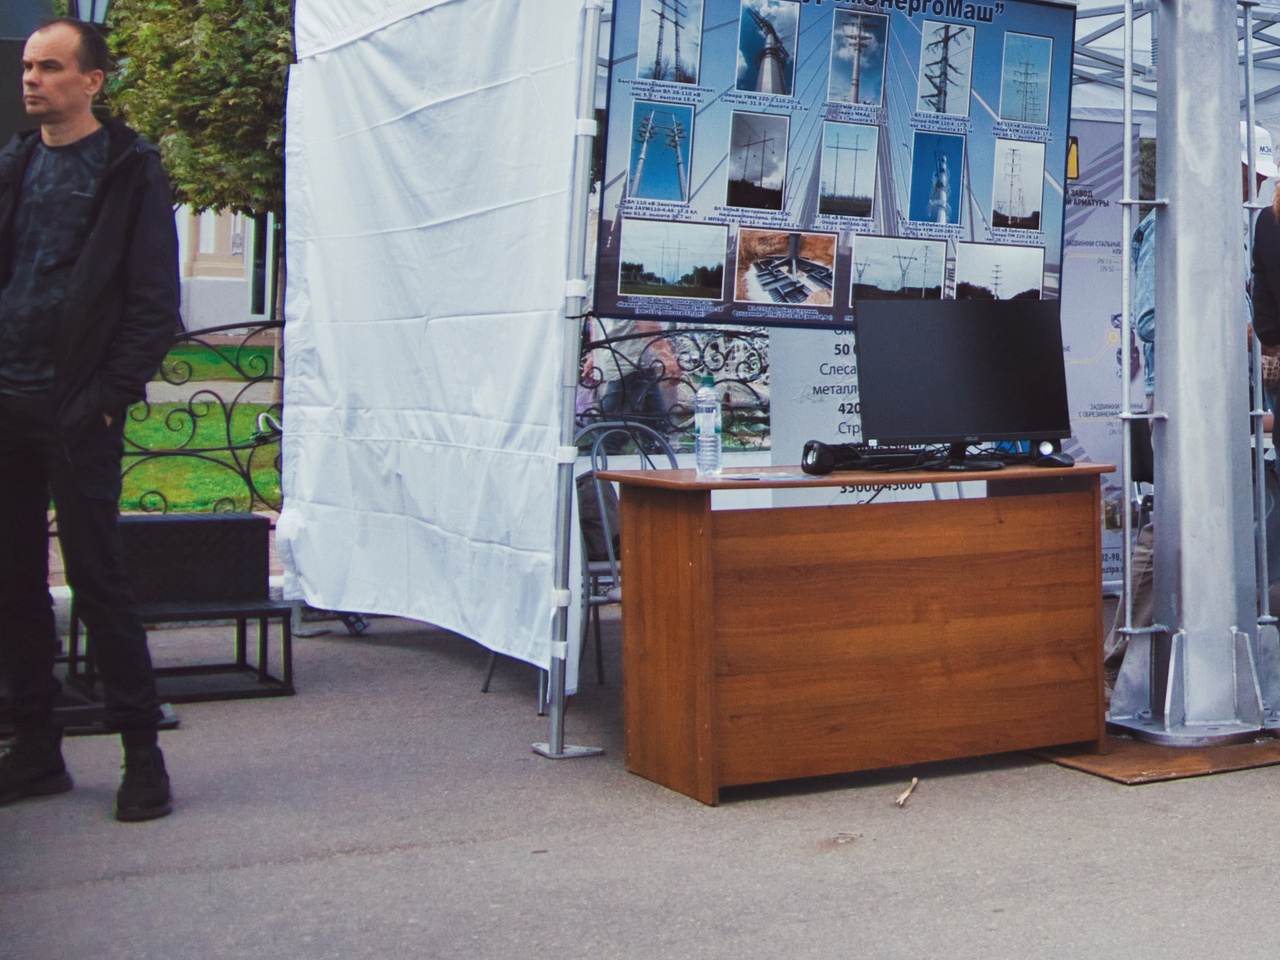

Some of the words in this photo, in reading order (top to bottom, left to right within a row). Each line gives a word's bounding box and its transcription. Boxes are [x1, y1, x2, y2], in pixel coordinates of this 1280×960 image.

[1073, 199, 1109, 207] АРМАТУРЫ
[819, 362, 856, 376] Слеса
[813, 385, 857, 395] металл
[838, 403, 861, 414] 420
[838, 421, 860, 436] Стр
